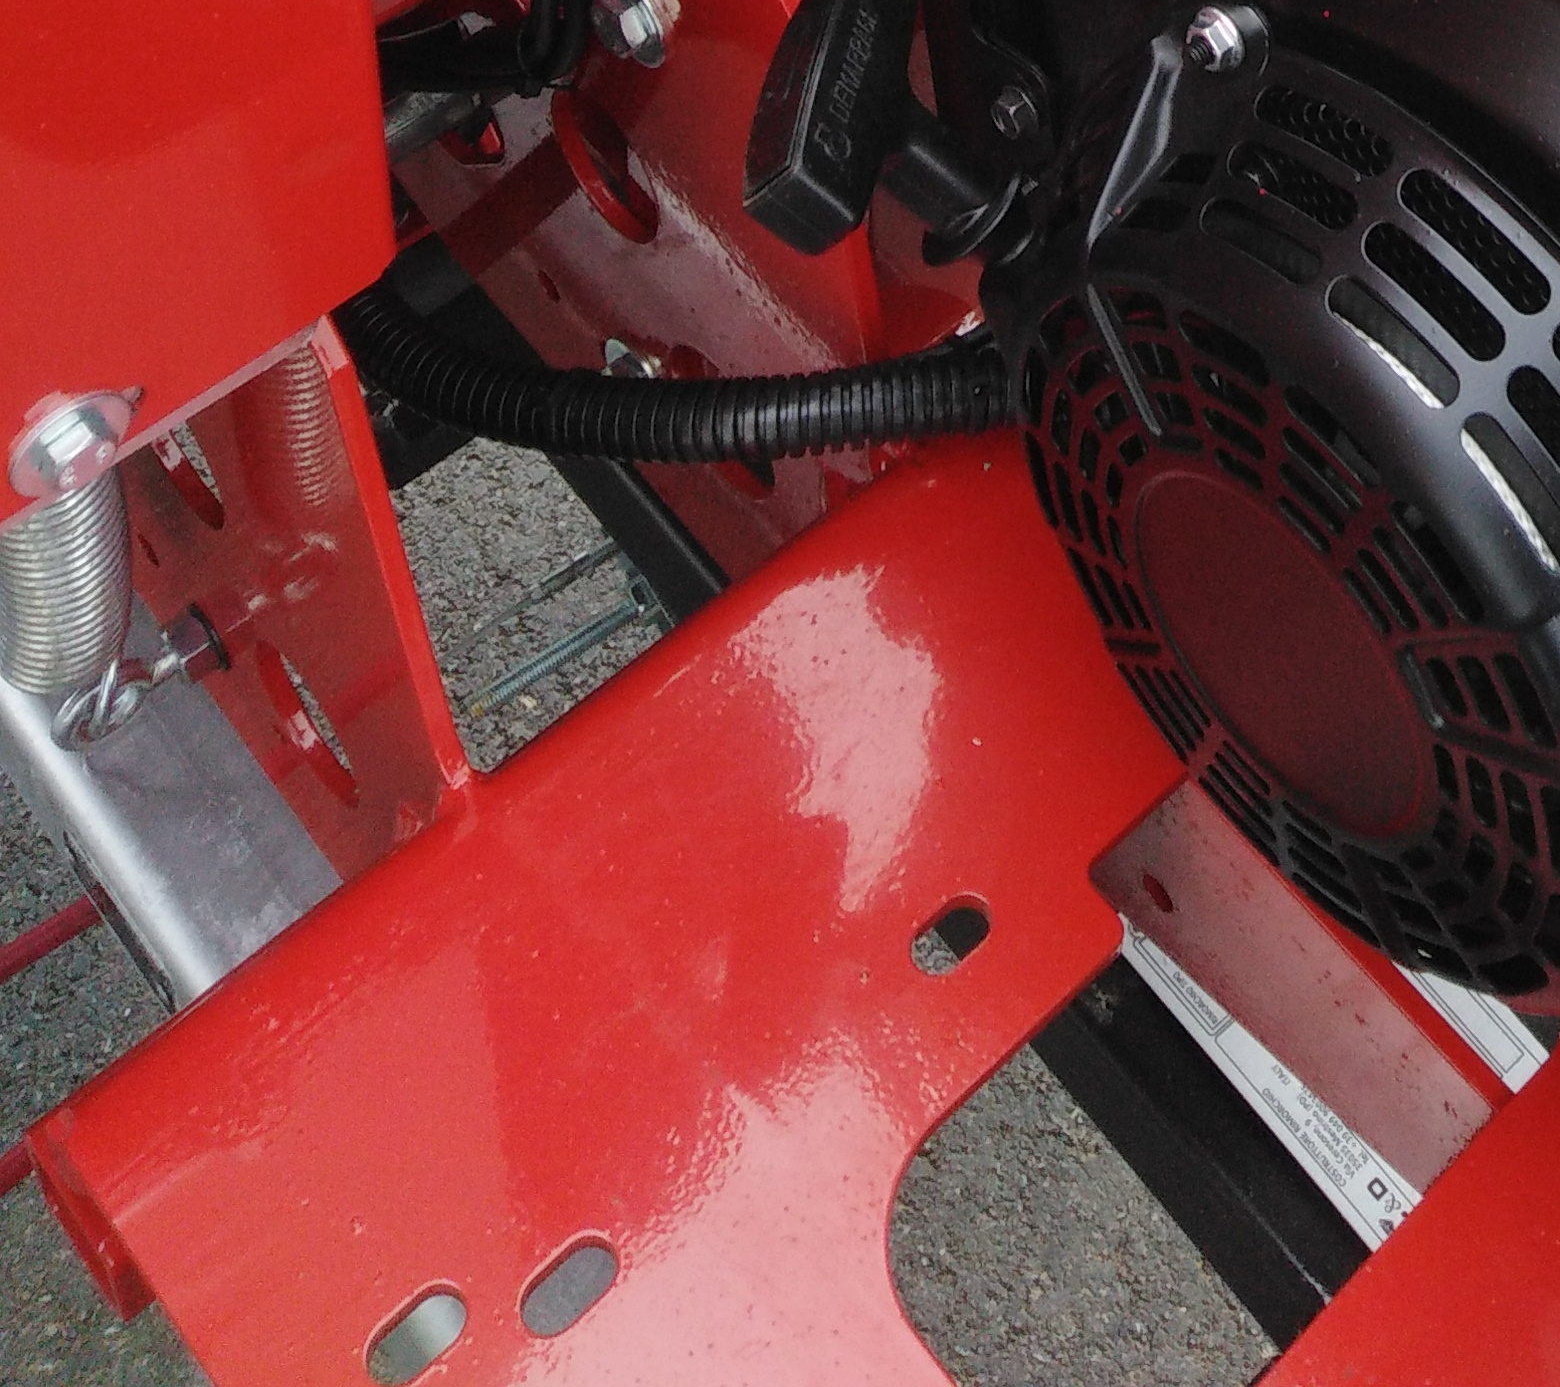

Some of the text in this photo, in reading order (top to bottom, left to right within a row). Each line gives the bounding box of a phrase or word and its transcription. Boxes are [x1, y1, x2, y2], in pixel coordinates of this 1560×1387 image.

[1269, 1062, 1291, 1086] ITALY
[1303, 1117, 1313, 1126] 9
[1309, 1109, 1343, 1146] Mestrino
[1327, 1114, 1344, 1133] 049
[1260, 1086, 1348, 1188] COSTRUTTORE RIMORCHIO
[1339, 1144, 1363, 1171] 35035
[1341, 1162, 1356, 1178] Via
